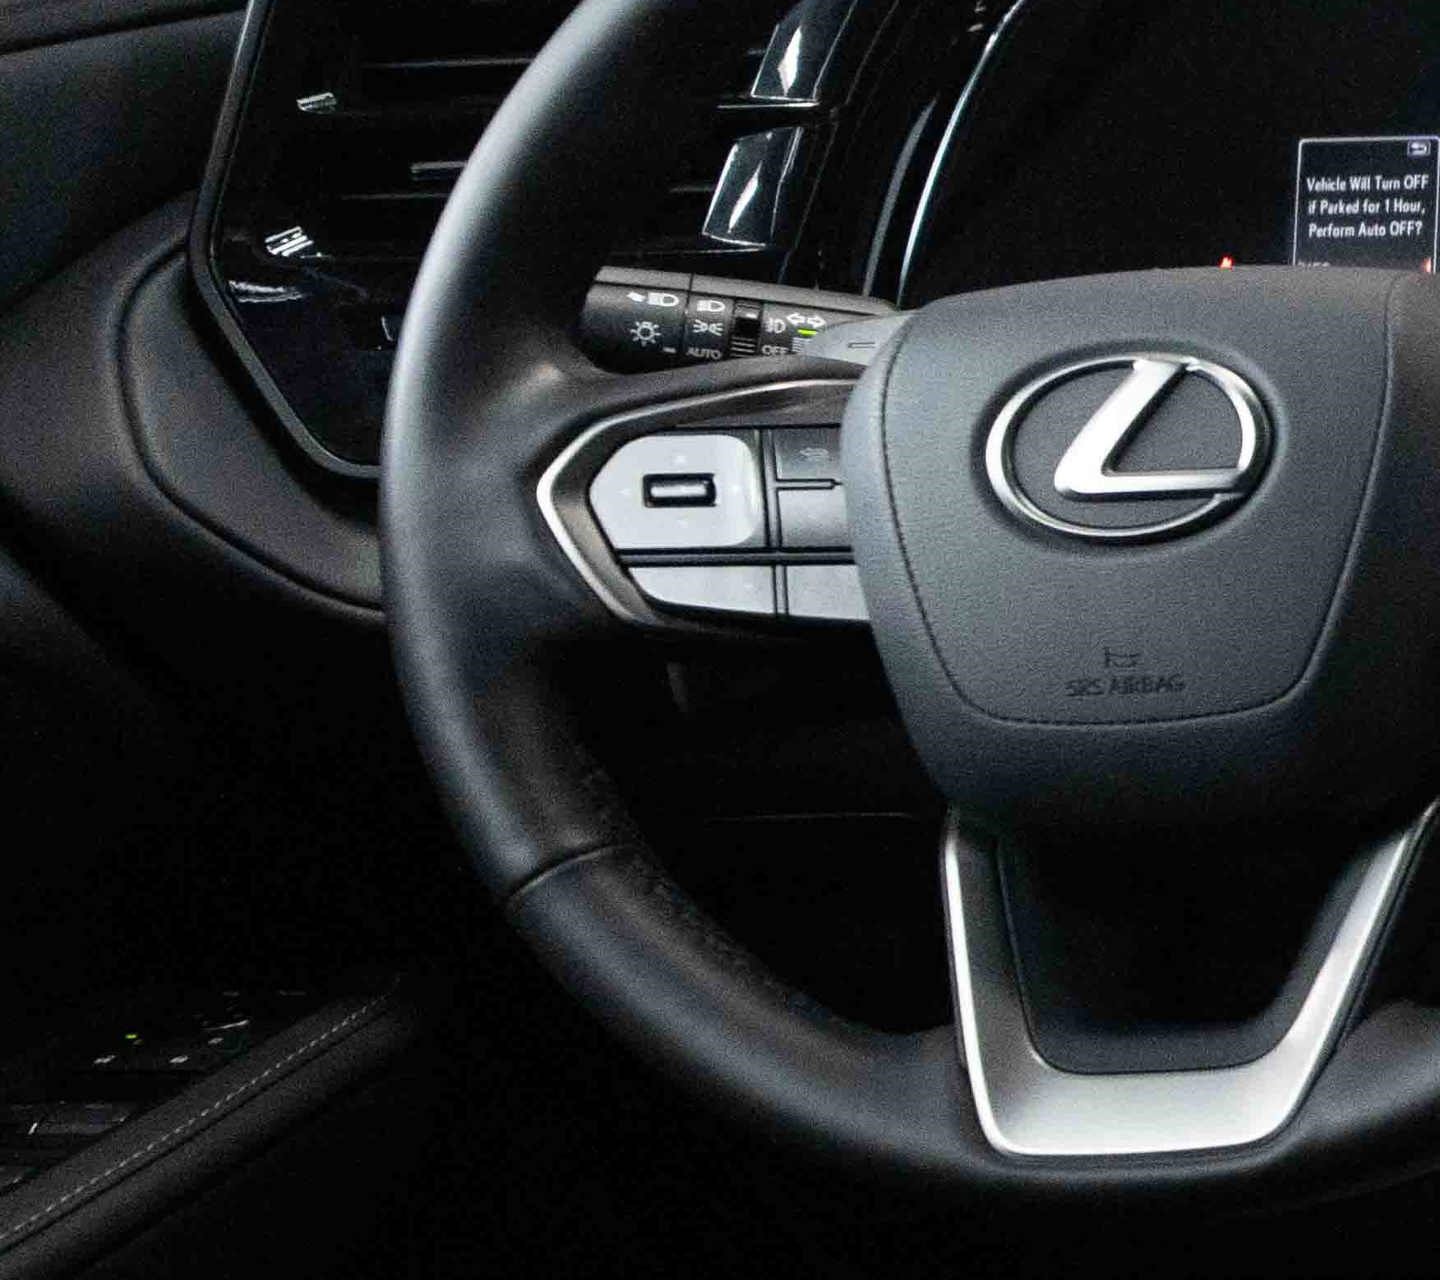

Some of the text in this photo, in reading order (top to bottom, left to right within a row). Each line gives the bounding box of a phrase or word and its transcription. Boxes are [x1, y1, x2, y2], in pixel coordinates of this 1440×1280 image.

[1306, 173, 1430, 193] Vehicle Will Turn OFF
[1319, 199, 1360, 215] Parked
[1363, 198, 1381, 214] for
[1308, 219, 1424, 239] Perform Auto OFF?
[686, 345, 722, 361] AUTO
